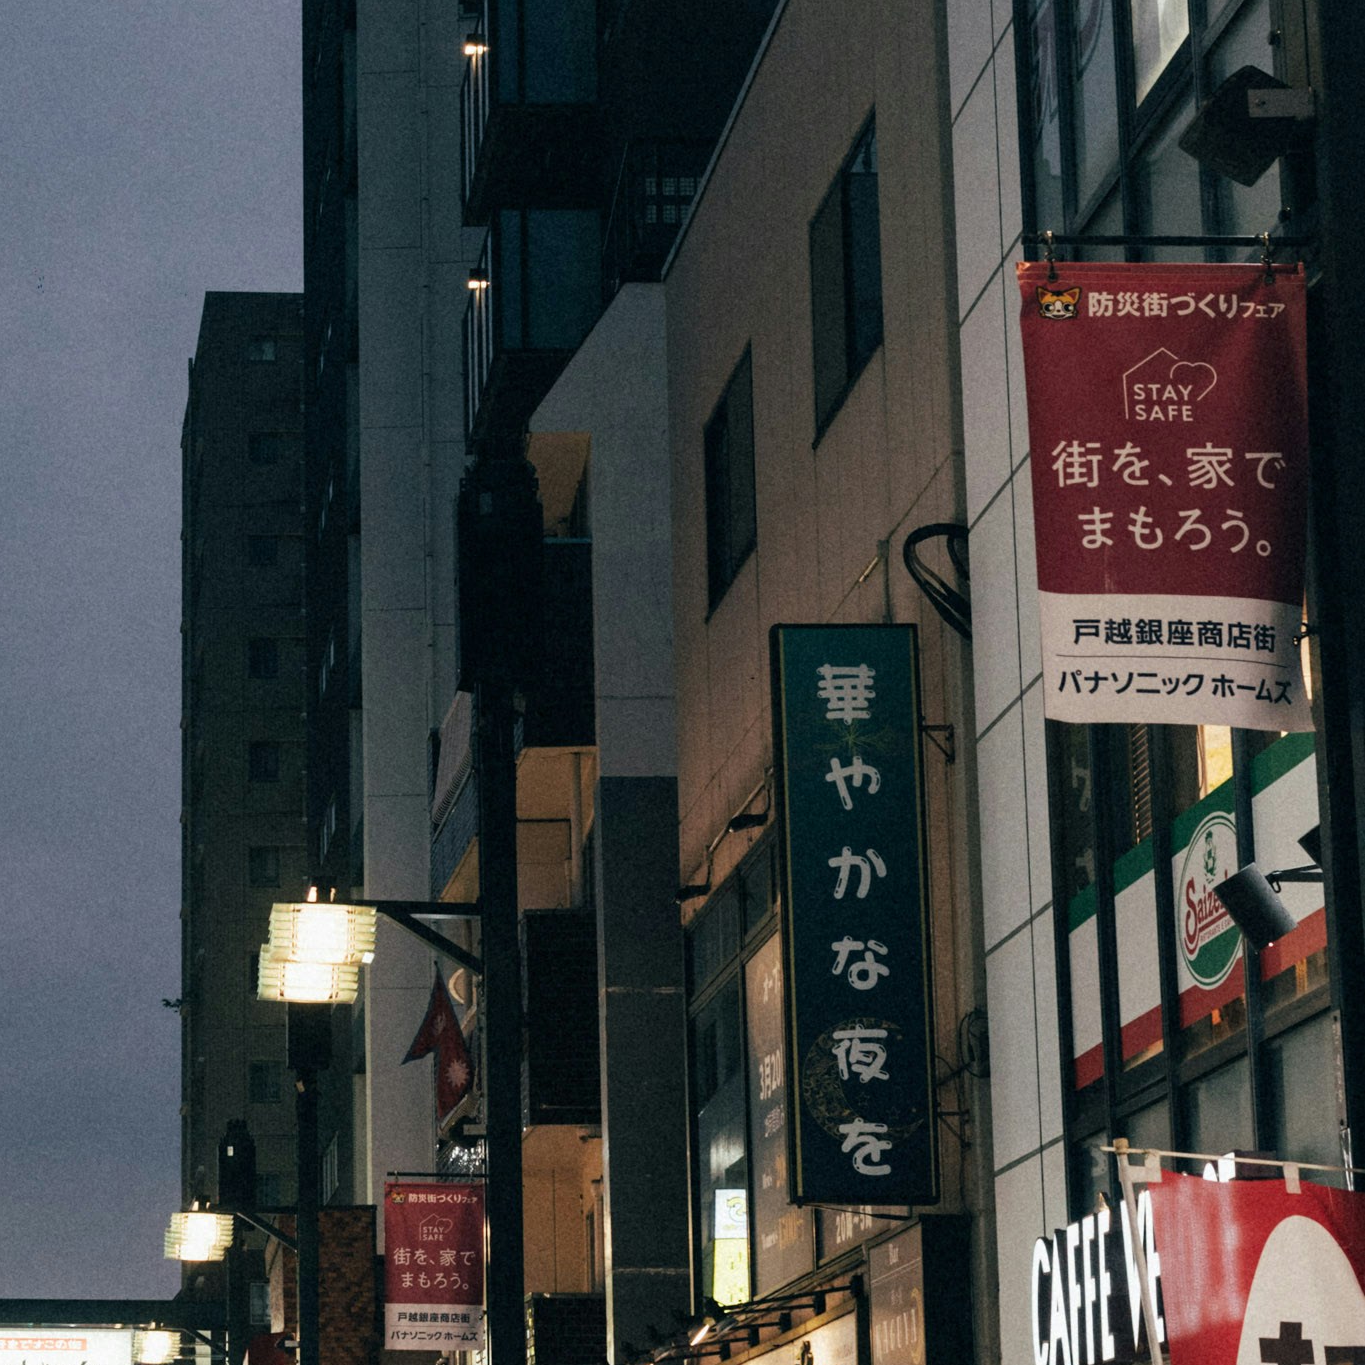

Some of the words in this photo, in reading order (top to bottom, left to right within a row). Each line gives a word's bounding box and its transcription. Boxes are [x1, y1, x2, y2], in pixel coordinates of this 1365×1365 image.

[1088, 291, 1286, 320] 防災街づくりフェア
[1133, 384, 1193, 401] STAY
[1134, 404, 1194, 422] SAFE
[1051, 440, 1286, 490] 街を、家で
[1078, 506, 1272, 557] まもろう。
[1072, 618, 1276, 654] 戸越銀座商店街
[1057, 669, 1205, 697] パナソニック
[1211, 673, 1292, 706] ホームズ
[815, 663, 893, 1176] 華やかな夜を
[408, 1193, 478, 1203] 防災街づくりフェア
[393, 1248, 476, 1266] 街を、家で
[401, 1272, 469, 1290] まもろう。
[397, 1312, 471, 1324] 戸越銀座商店街
